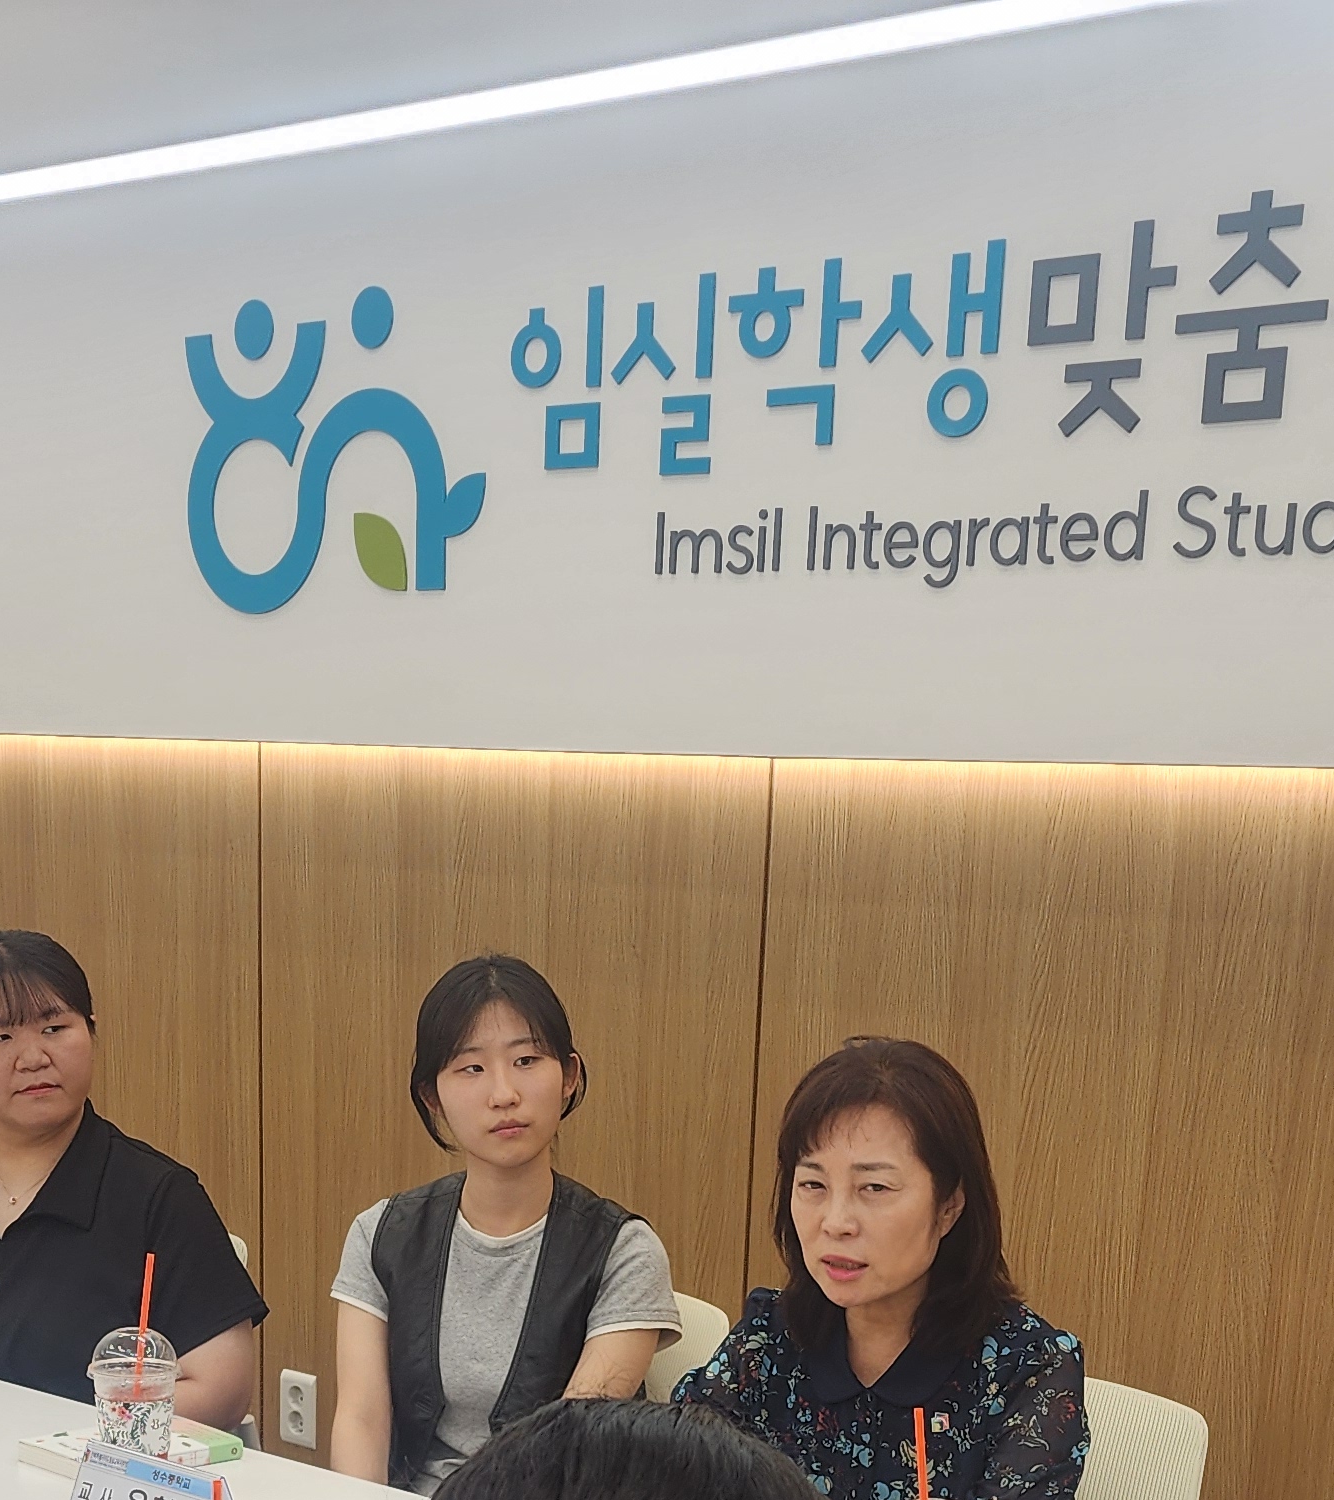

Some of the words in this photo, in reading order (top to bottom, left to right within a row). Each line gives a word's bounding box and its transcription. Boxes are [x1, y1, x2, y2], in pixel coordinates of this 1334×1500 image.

[654, 507, 784, 577] Imsil
[806, 489, 1150, 590] Integrated
[152, 1469, 192, 1490] 성수중학교
